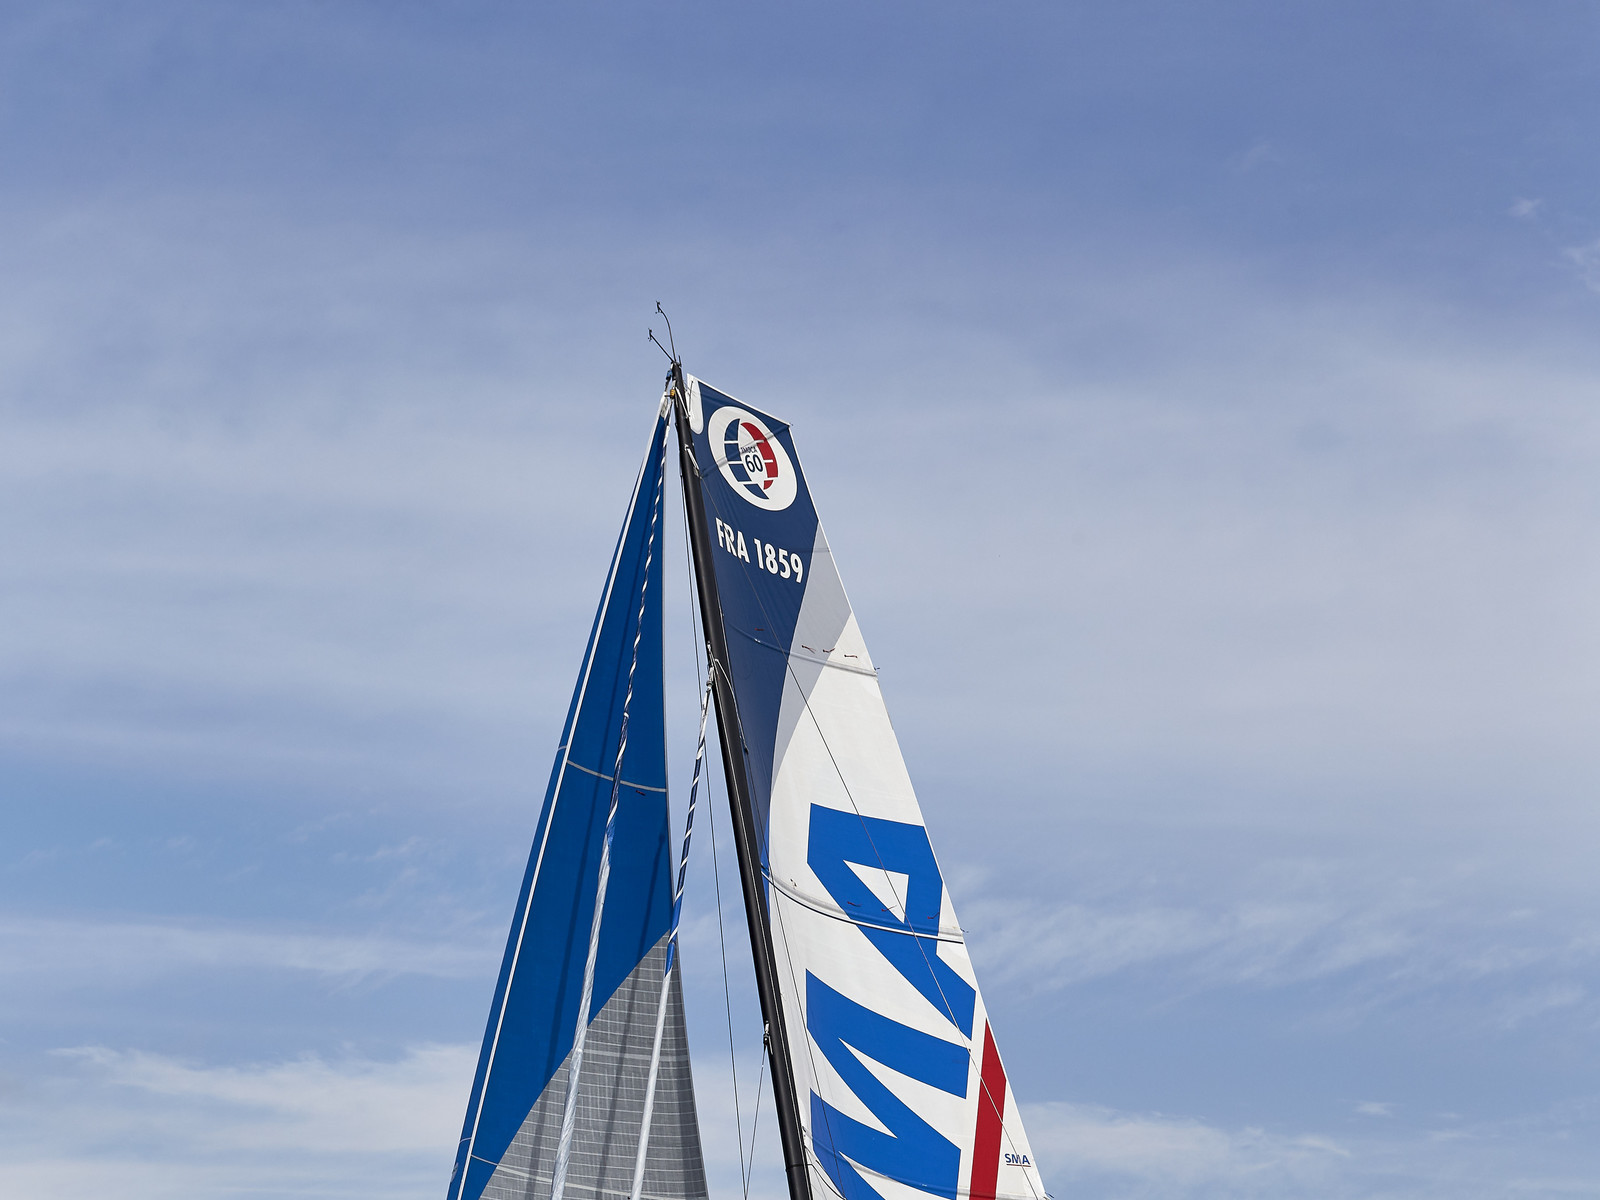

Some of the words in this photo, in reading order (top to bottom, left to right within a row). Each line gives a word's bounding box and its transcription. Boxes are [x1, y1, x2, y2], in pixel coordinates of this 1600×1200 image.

[745, 454, 763, 472] 60
[715, 517, 750, 563] FRA
[753, 538, 803, 583] 1859
[1004, 1153, 1030, 1165] SMA
